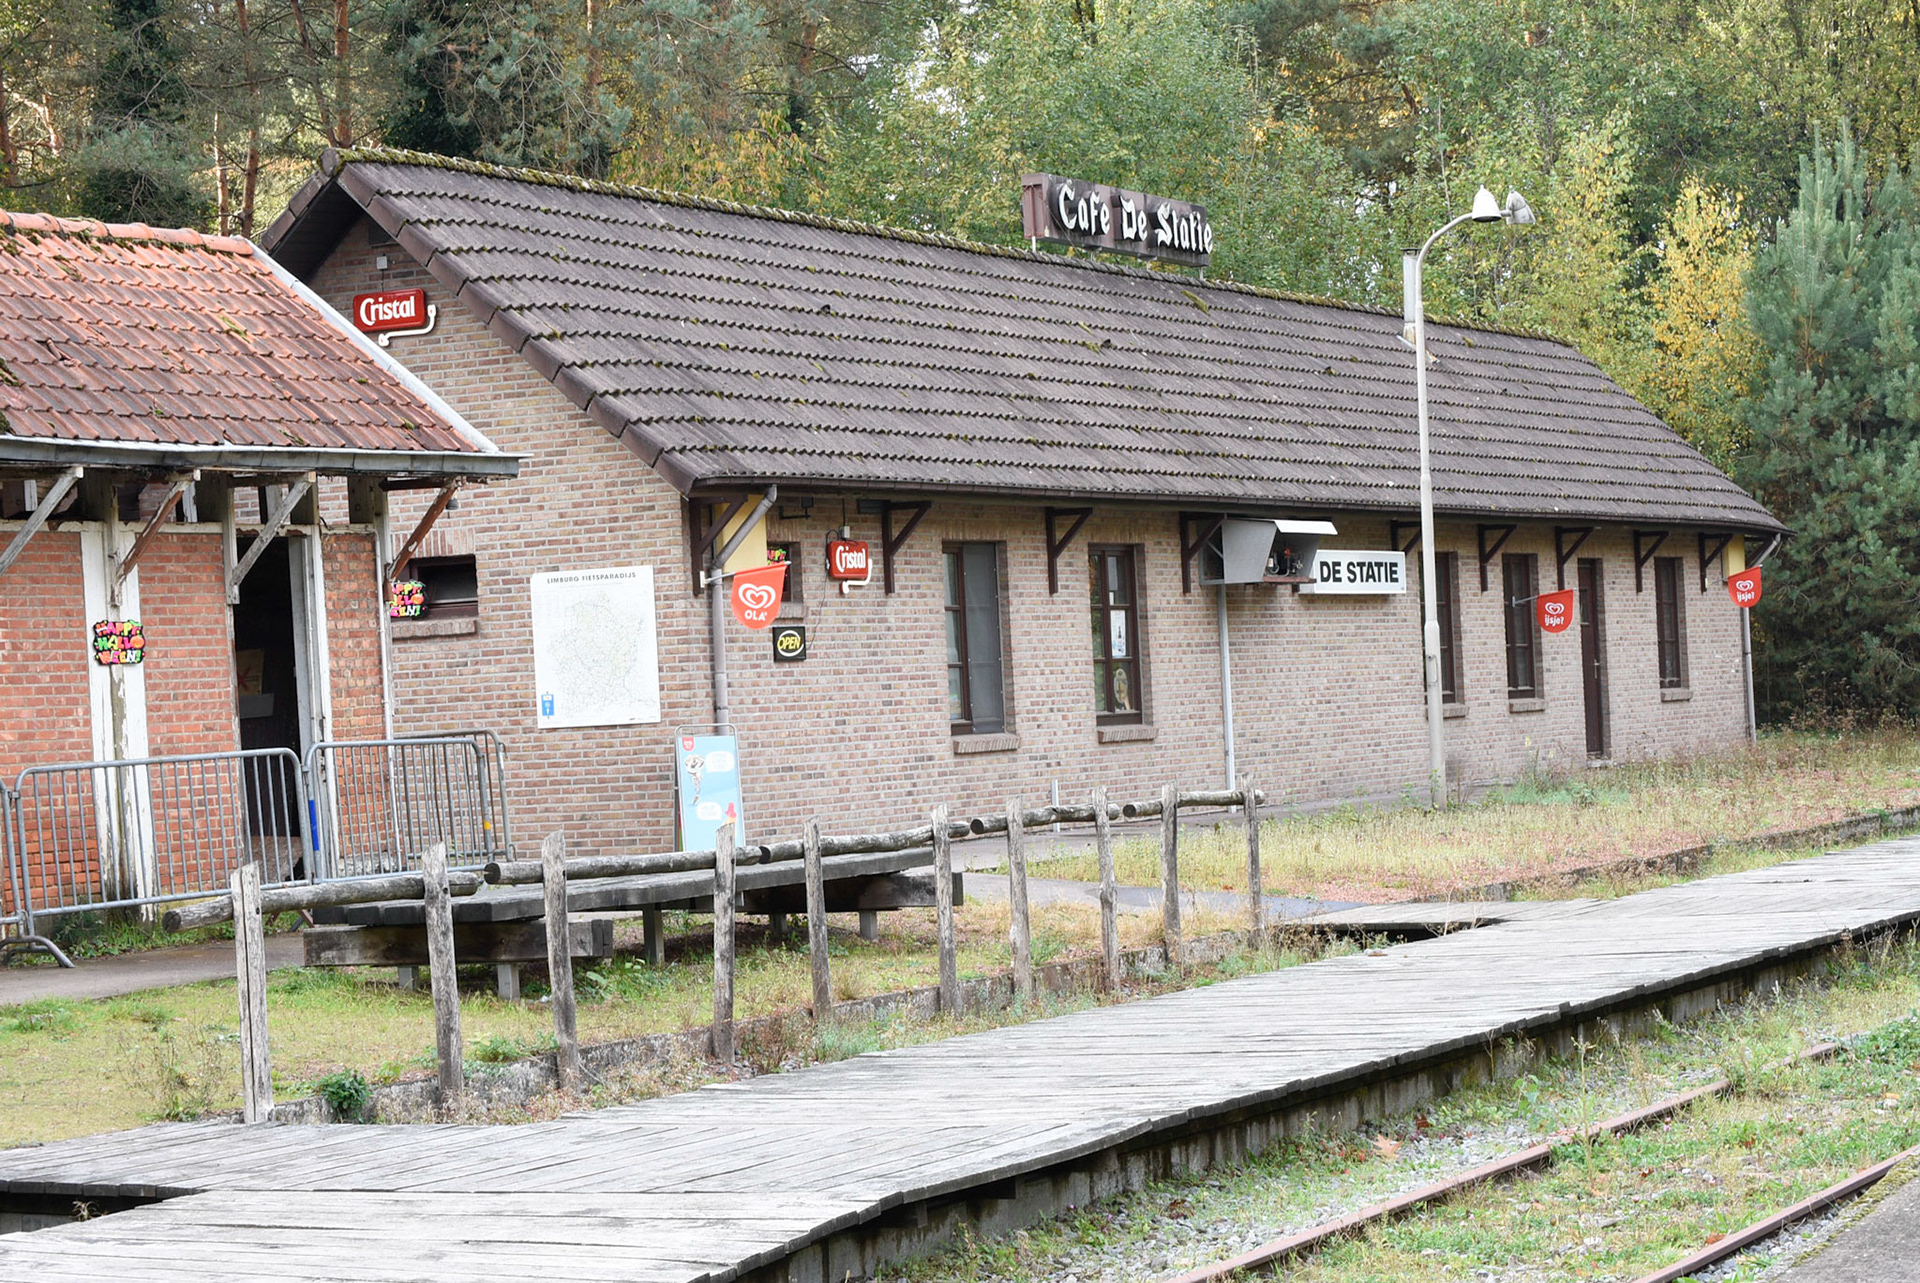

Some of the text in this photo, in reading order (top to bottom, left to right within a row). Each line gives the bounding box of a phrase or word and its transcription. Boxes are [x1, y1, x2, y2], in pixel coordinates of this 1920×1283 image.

[1120, 195, 1148, 241] De
[1155, 202, 1213, 255] Statie
[360, 295, 416, 327] Cristal
[835, 544, 866, 573] Cristal
[547, 571, 637, 584] LIMBURG FIETSPARADIJS
[1319, 560, 1399, 584] DE STATIE
[1736, 591, 1755, 603] ijsje?
[744, 609, 767, 621] OLA
[1544, 613, 1565, 627] ijsje?
[95, 620, 142, 637] HAPPY
[777, 636, 801, 650] OPEN
